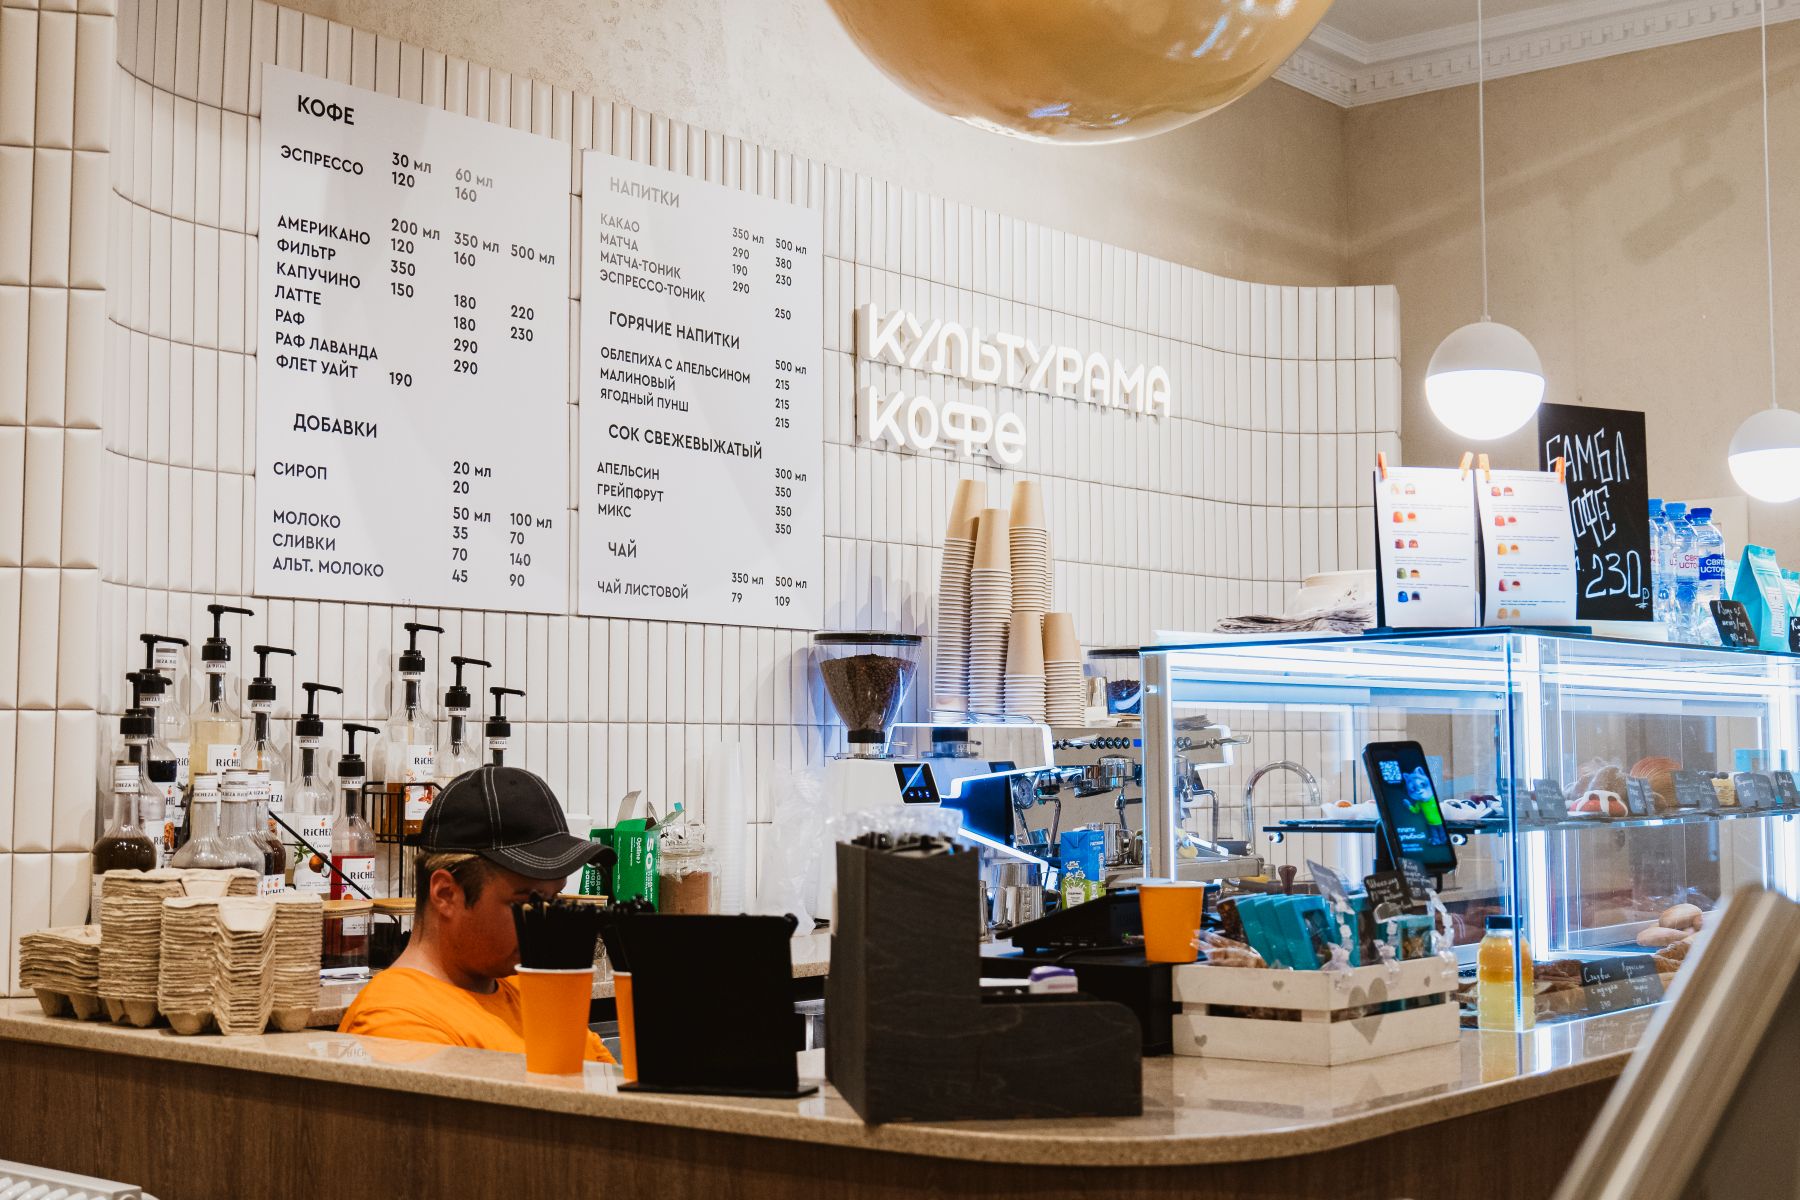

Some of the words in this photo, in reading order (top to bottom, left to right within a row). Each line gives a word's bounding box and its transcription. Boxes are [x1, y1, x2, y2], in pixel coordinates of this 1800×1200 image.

[298, 95, 354, 125] КОФЕ
[281, 145, 363, 175] ЭСПРЕССО
[392, 172, 415, 188] 120
[456, 187, 477, 202] 160
[392, 152, 409, 168] 30
[414, 161, 431, 173] мл
[456, 168, 471, 183] 60
[477, 176, 493, 188] мл
[611, 177, 679, 208] НАПИТКИ
[277, 239, 336, 260] ФИЛЬТР
[391, 260, 416, 276] 350
[278, 215, 370, 245] АМЕРИКАНО
[391, 238, 414, 254] 120
[454, 252, 476, 267] 160
[392, 218, 418, 235] 200
[423, 228, 440, 240] мл
[454, 232, 478, 248] 350
[483, 241, 499, 253] мл
[511, 244, 535, 260] 500
[540, 254, 555, 265] мл
[600, 232, 639, 252] МАТЧА
[733, 264, 748, 276] 190
[776, 274, 792, 286] 230
[601, 214, 640, 233] КАКАО
[733, 247, 750, 260] 290
[776, 257, 792, 270] 380
[733, 227, 749, 240] 350
[753, 235, 764, 244] мл
[776, 238, 793, 251] 500
[796, 246, 807, 255] мл
[600, 250, 681, 280] МАТЧА-ТОНИК
[733, 281, 750, 294] 290
[277, 262, 360, 289] КАПУЧИНО
[391, 282, 414, 298] 150
[454, 294, 476, 310] 180
[511, 305, 534, 320] 220
[600, 268, 706, 303] ЭСПРЕССО-ТОНИК
[775, 308, 791, 320] 250
[275, 285, 321, 305] ЛАТТЕ
[454, 316, 476, 331] 180
[511, 327, 533, 342] 230
[276, 309, 305, 325] РАФ
[454, 338, 478, 354] 290
[610, 311, 672, 336] ГОРЯЧИЕ
[677, 325, 739, 349] НАПИТКИ
[276, 332, 305, 348] РАФ
[310, 338, 378, 361] ЛАВАНДА
[454, 359, 478, 375] 290
[276, 355, 317, 372] ФЛЕТ
[321, 360, 358, 378] УАЙТ
[390, 372, 412, 387] 190
[601, 347, 662, 368] ОБЛЕПИХА
[665, 359, 673, 370] С
[676, 361, 750, 384] АПЕЛЬСИНОМ
[776, 379, 790, 390] 215
[776, 360, 792, 372] 500
[796, 366, 806, 375] мл
[866, 302, 1171, 418] КУЛЬТУРАМА
[600, 368, 675, 391] МАЛИНОВЫЙ
[776, 398, 789, 410] 215
[294, 414, 377, 438] ДОБАВКИ
[601, 388, 653, 406] ЯГОДНЫЙ
[658, 397, 688, 412] ПУНШ
[776, 417, 790, 429] 215
[609, 424, 639, 442] СОК
[644, 430, 762, 459] СВЕЖЕВЫЖАТЫЙ
[274, 462, 327, 480] СИРОП
[453, 480, 469, 494] 20
[454, 461, 470, 475] 20
[475, 467, 491, 478] мл
[597, 462, 659, 480] АПЕЛЬСИН
[776, 486, 791, 498] 350
[776, 468, 792, 480] 300
[795, 474, 807, 482] мл
[598, 482, 664, 502] ГРЕЙПФРУТ
[776, 506, 792, 517] 350
[1571, 485, 1616, 549] ОФЕ
[274, 510, 341, 528] МОЛОКО
[453, 526, 468, 540] 35
[510, 532, 524, 545] 70
[453, 507, 469, 520] 50
[475, 512, 491, 523] мл
[510, 513, 532, 527] 100
[537, 518, 552, 529] мл
[598, 504, 631, 518] МИКС
[776, 524, 792, 535] 350
[273, 533, 335, 551] СЛИВКИ
[453, 548, 468, 561] 70
[510, 553, 531, 566] 140
[608, 539, 636, 558] ЧАЙ
[273, 557, 313, 572] АЛЬТ.
[319, 560, 384, 577] МОЛОКО
[452, 570, 468, 583] 45
[510, 574, 525, 587] 90
[732, 572, 749, 584] 350
[752, 577, 764, 585] мл
[776, 576, 793, 587] 500
[598, 579, 621, 594] ЧАЙ
[625, 584, 688, 599] ЛИСТОВОЙ
[732, 592, 742, 603] 79
[775, 596, 790, 606] 109
